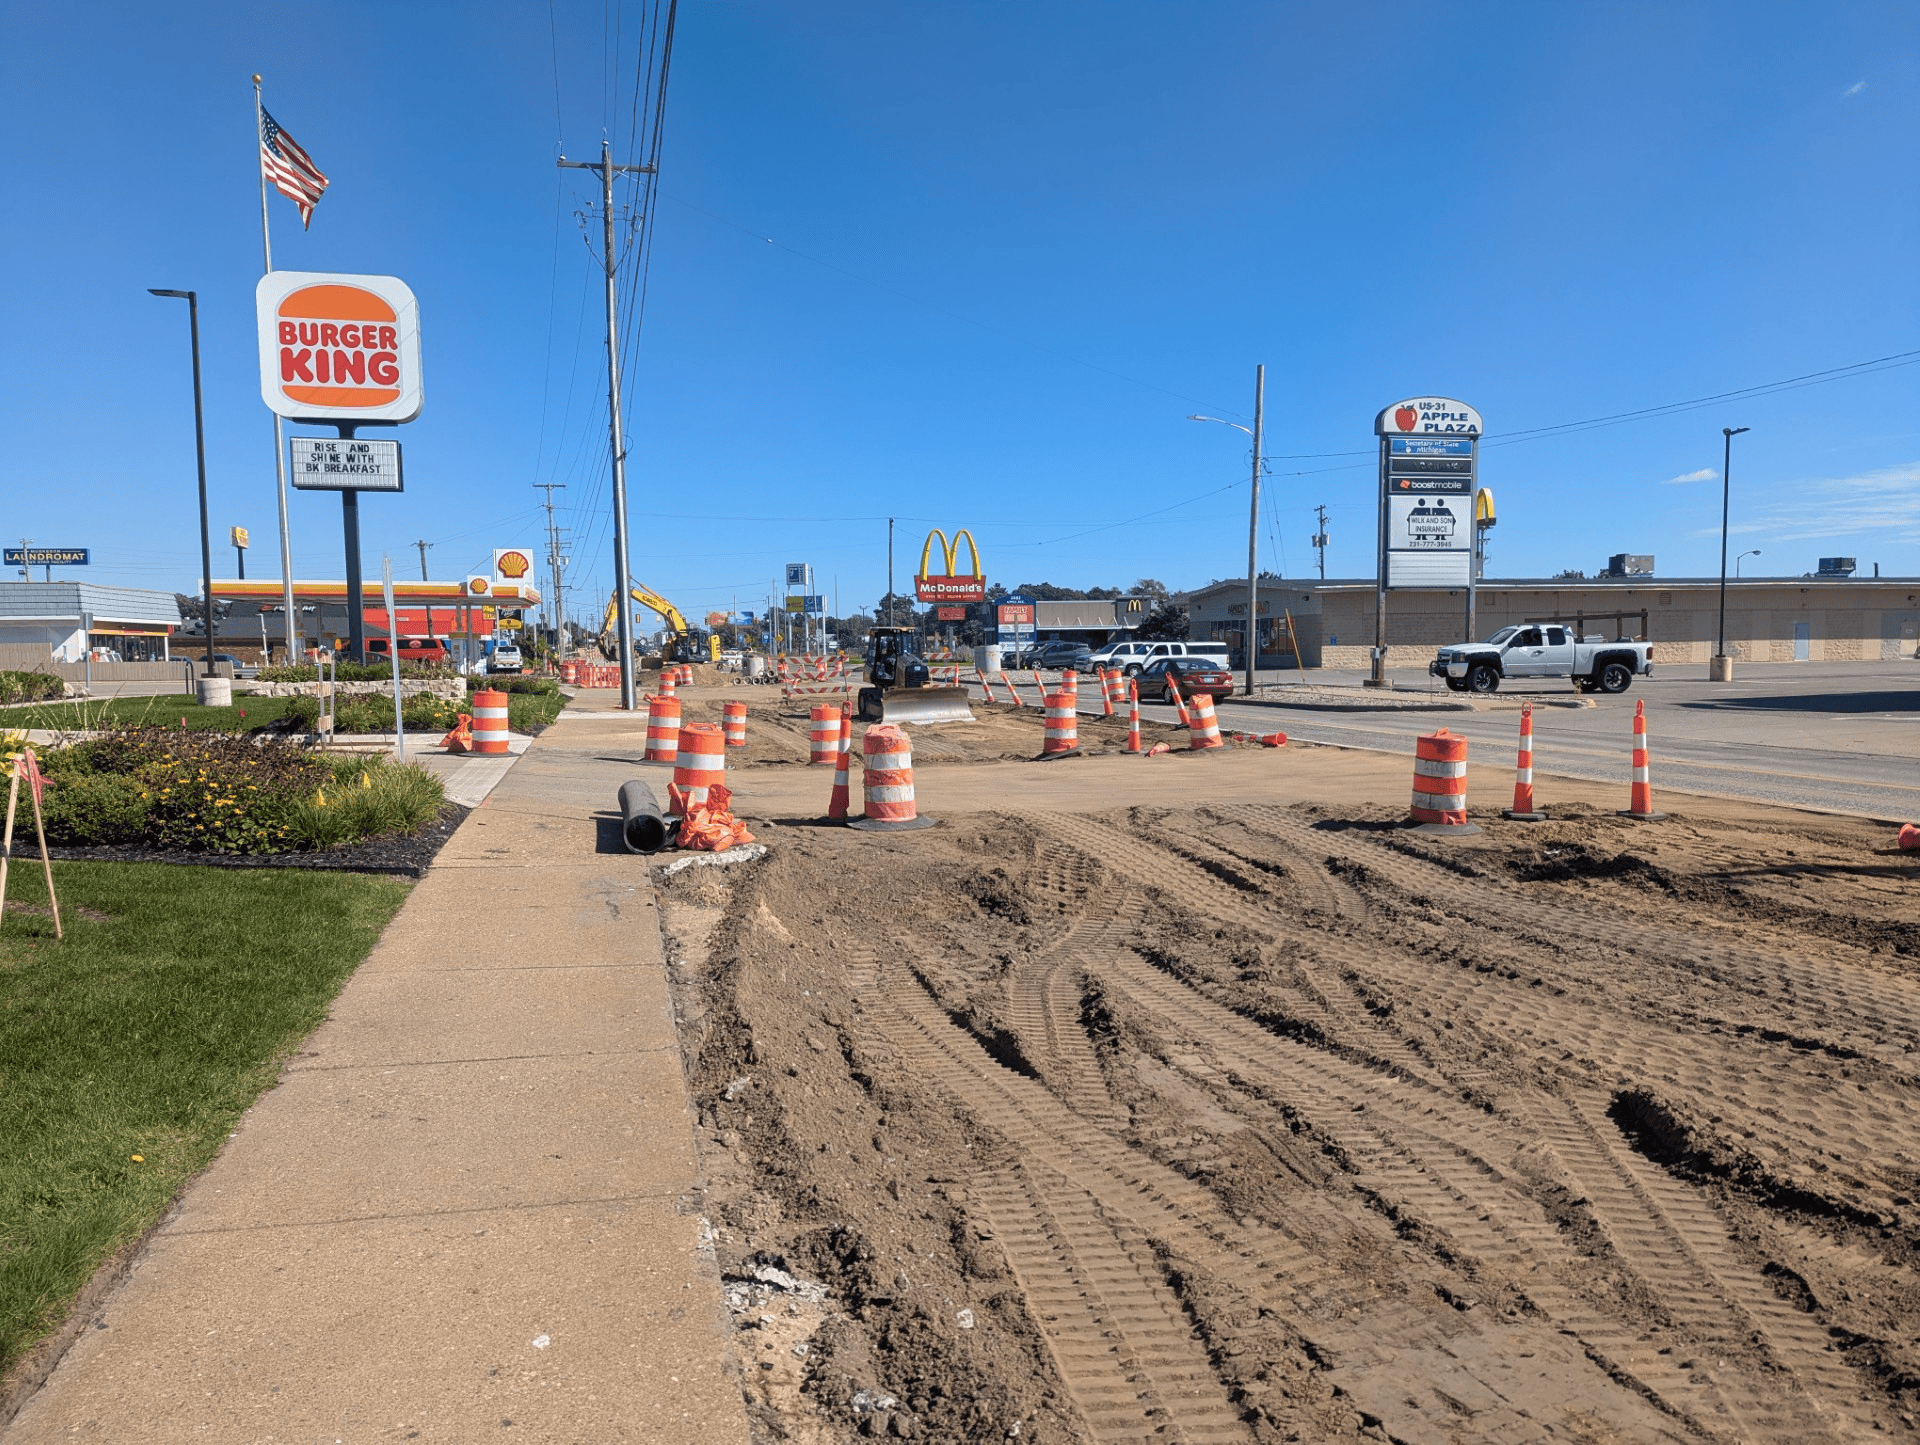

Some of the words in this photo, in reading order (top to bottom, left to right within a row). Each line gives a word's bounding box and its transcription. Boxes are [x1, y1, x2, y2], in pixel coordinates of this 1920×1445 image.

[279, 321, 398, 350] BURGER
[280, 347, 400, 386] KING
[1421, 412, 1468, 422] APPLE
[1424, 423, 1478, 433] PLAZA
[314, 442, 337, 452] RISE
[349, 445, 370, 454] AND
[1405, 440, 1433, 449] Secretary
[1442, 441, 1460, 449] State
[1417, 447, 1447, 455] Michigan
[310, 452, 341, 463] SHINE
[346, 454, 375, 464] WITH
[306, 463, 320, 472] BK
[324, 464, 381, 474] BREAKFAST
[1426, 517, 1439, 525] AND
[1440, 517, 1453, 525] SON
[1415, 526, 1448, 534] INSURANCE
[6, 553, 85, 561] LAUNDROMAT
[920, 583, 982, 592] McDonald's
